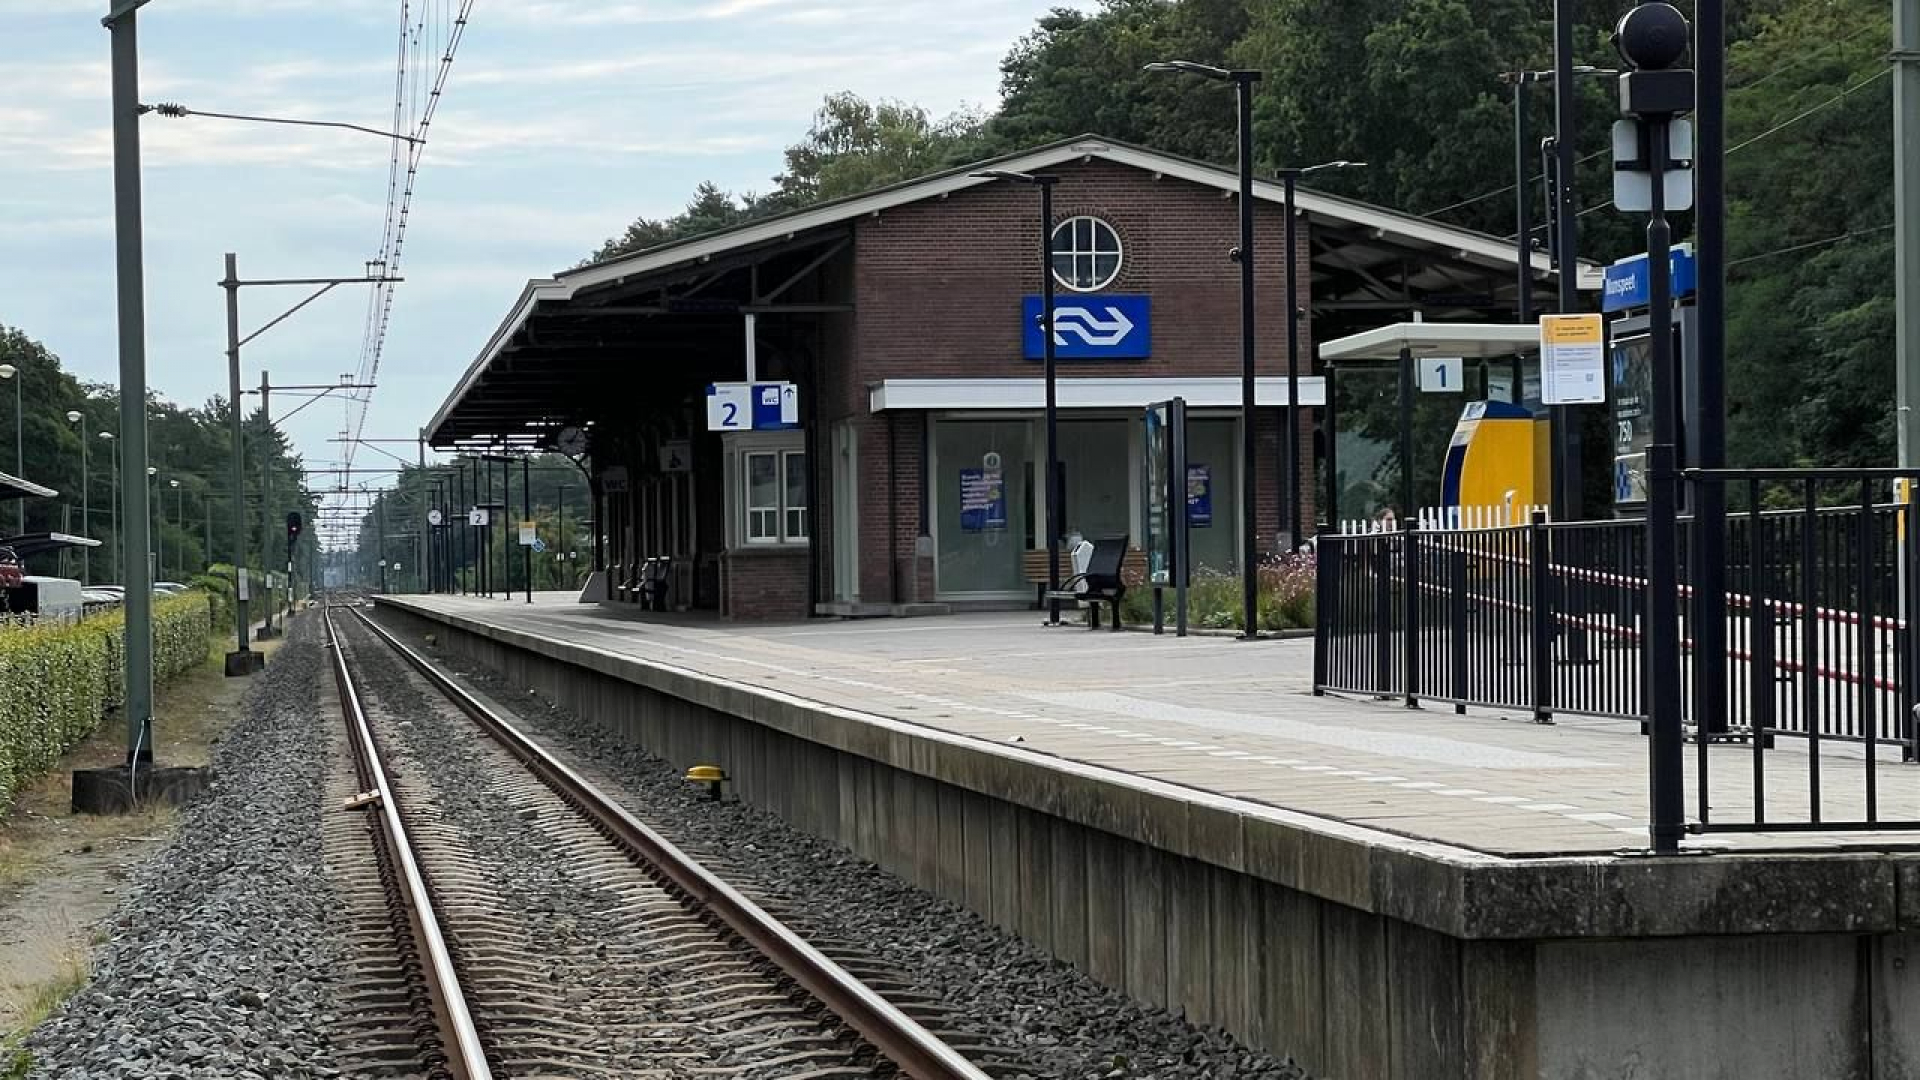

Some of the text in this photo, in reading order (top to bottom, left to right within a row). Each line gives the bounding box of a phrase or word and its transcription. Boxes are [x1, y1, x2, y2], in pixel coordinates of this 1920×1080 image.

[1435, 363, 1447, 388] 1
[722, 402, 739, 427] 2
[475, 513, 482, 524] 2
